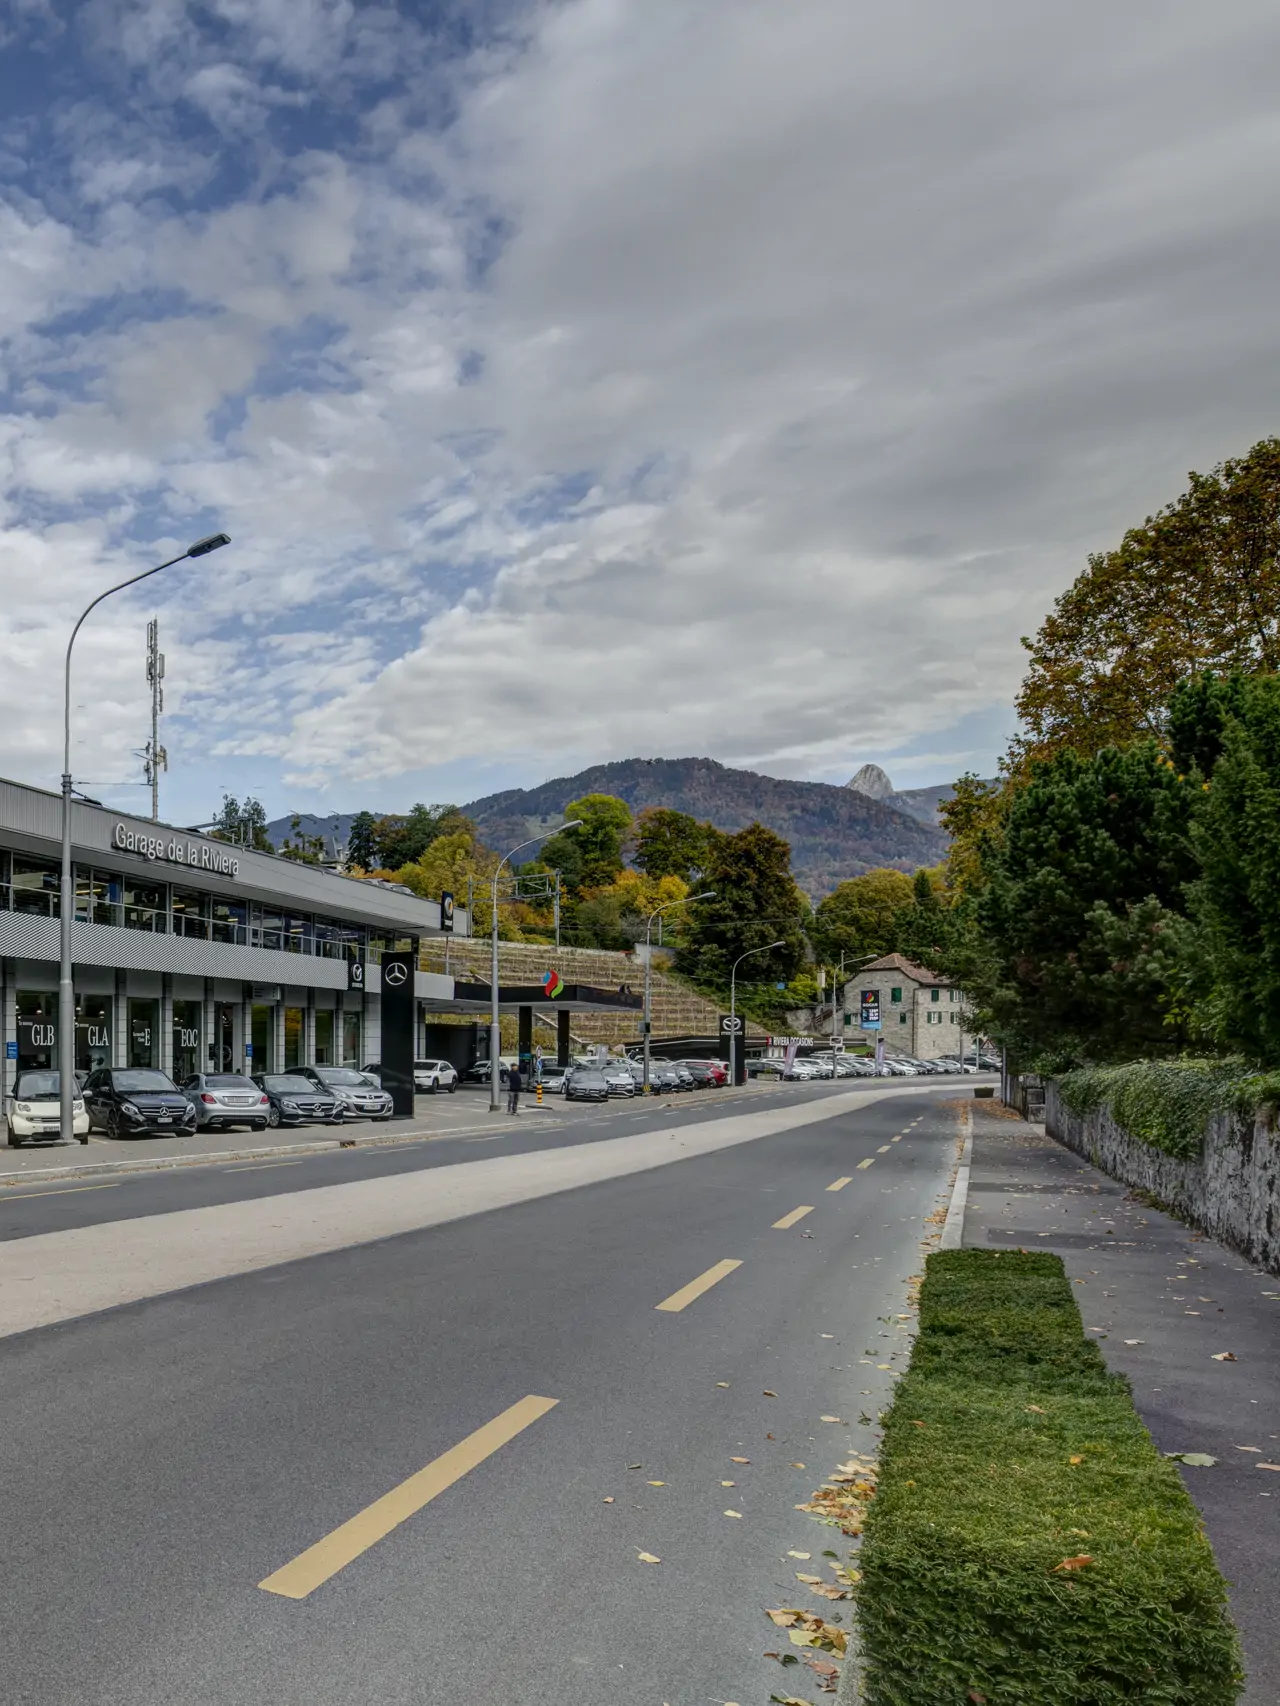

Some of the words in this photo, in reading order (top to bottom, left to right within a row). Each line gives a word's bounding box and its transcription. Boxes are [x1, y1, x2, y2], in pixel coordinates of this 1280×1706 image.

[115, 822, 165, 860] Garage
[168, 837, 184, 862] de
[187, 842, 198, 865] la
[202, 845, 239, 875] Riviera
[31, 1024, 55, 1046] GLB
[87, 1026, 109, 1046] GLA
[144, 1028, 151, 1046] E
[180, 1028, 198, 1047] EQC
[773, 1036, 790, 1046] RIVIERA
